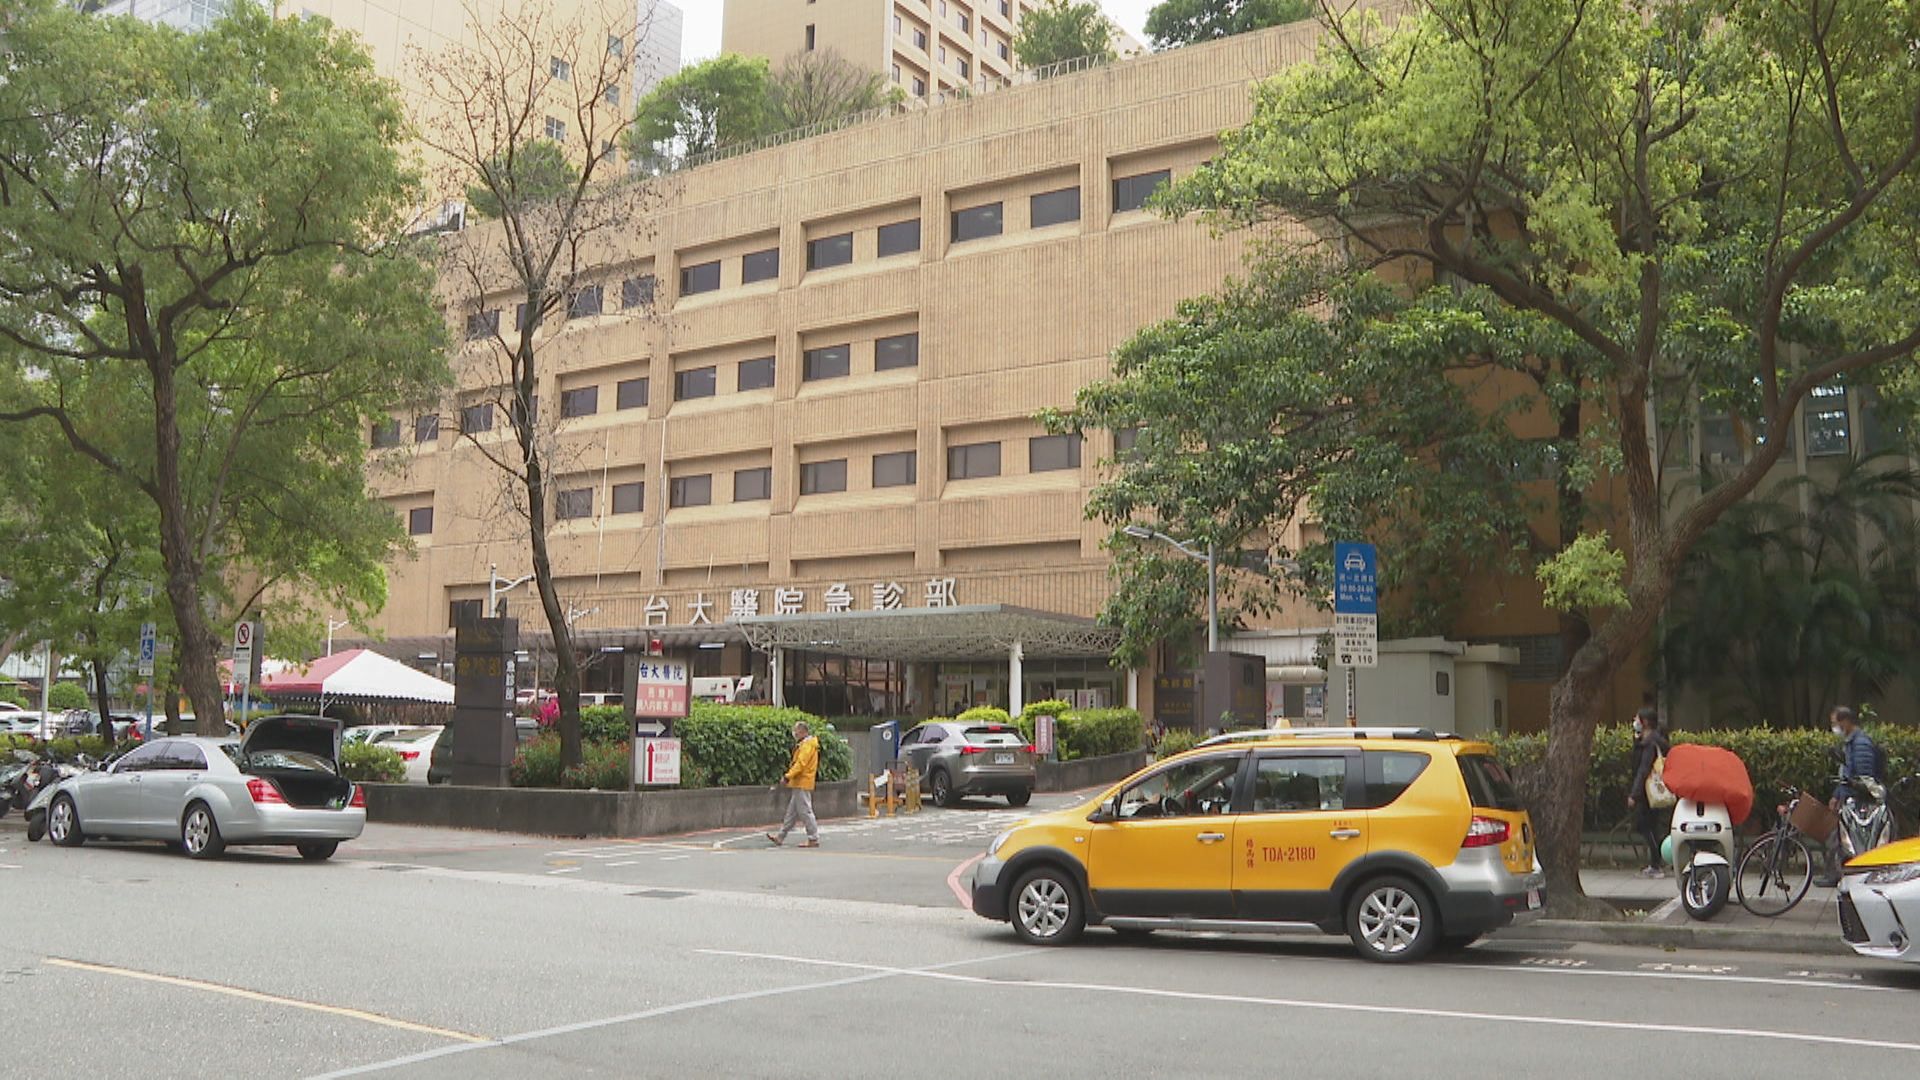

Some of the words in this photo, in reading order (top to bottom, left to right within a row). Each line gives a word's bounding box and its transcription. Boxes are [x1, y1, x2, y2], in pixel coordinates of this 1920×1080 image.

[643, 577, 958, 626] 台大醫院急診部
[1358, 655, 1373, 664] 110
[640, 663, 683, 680] 台大醫院
